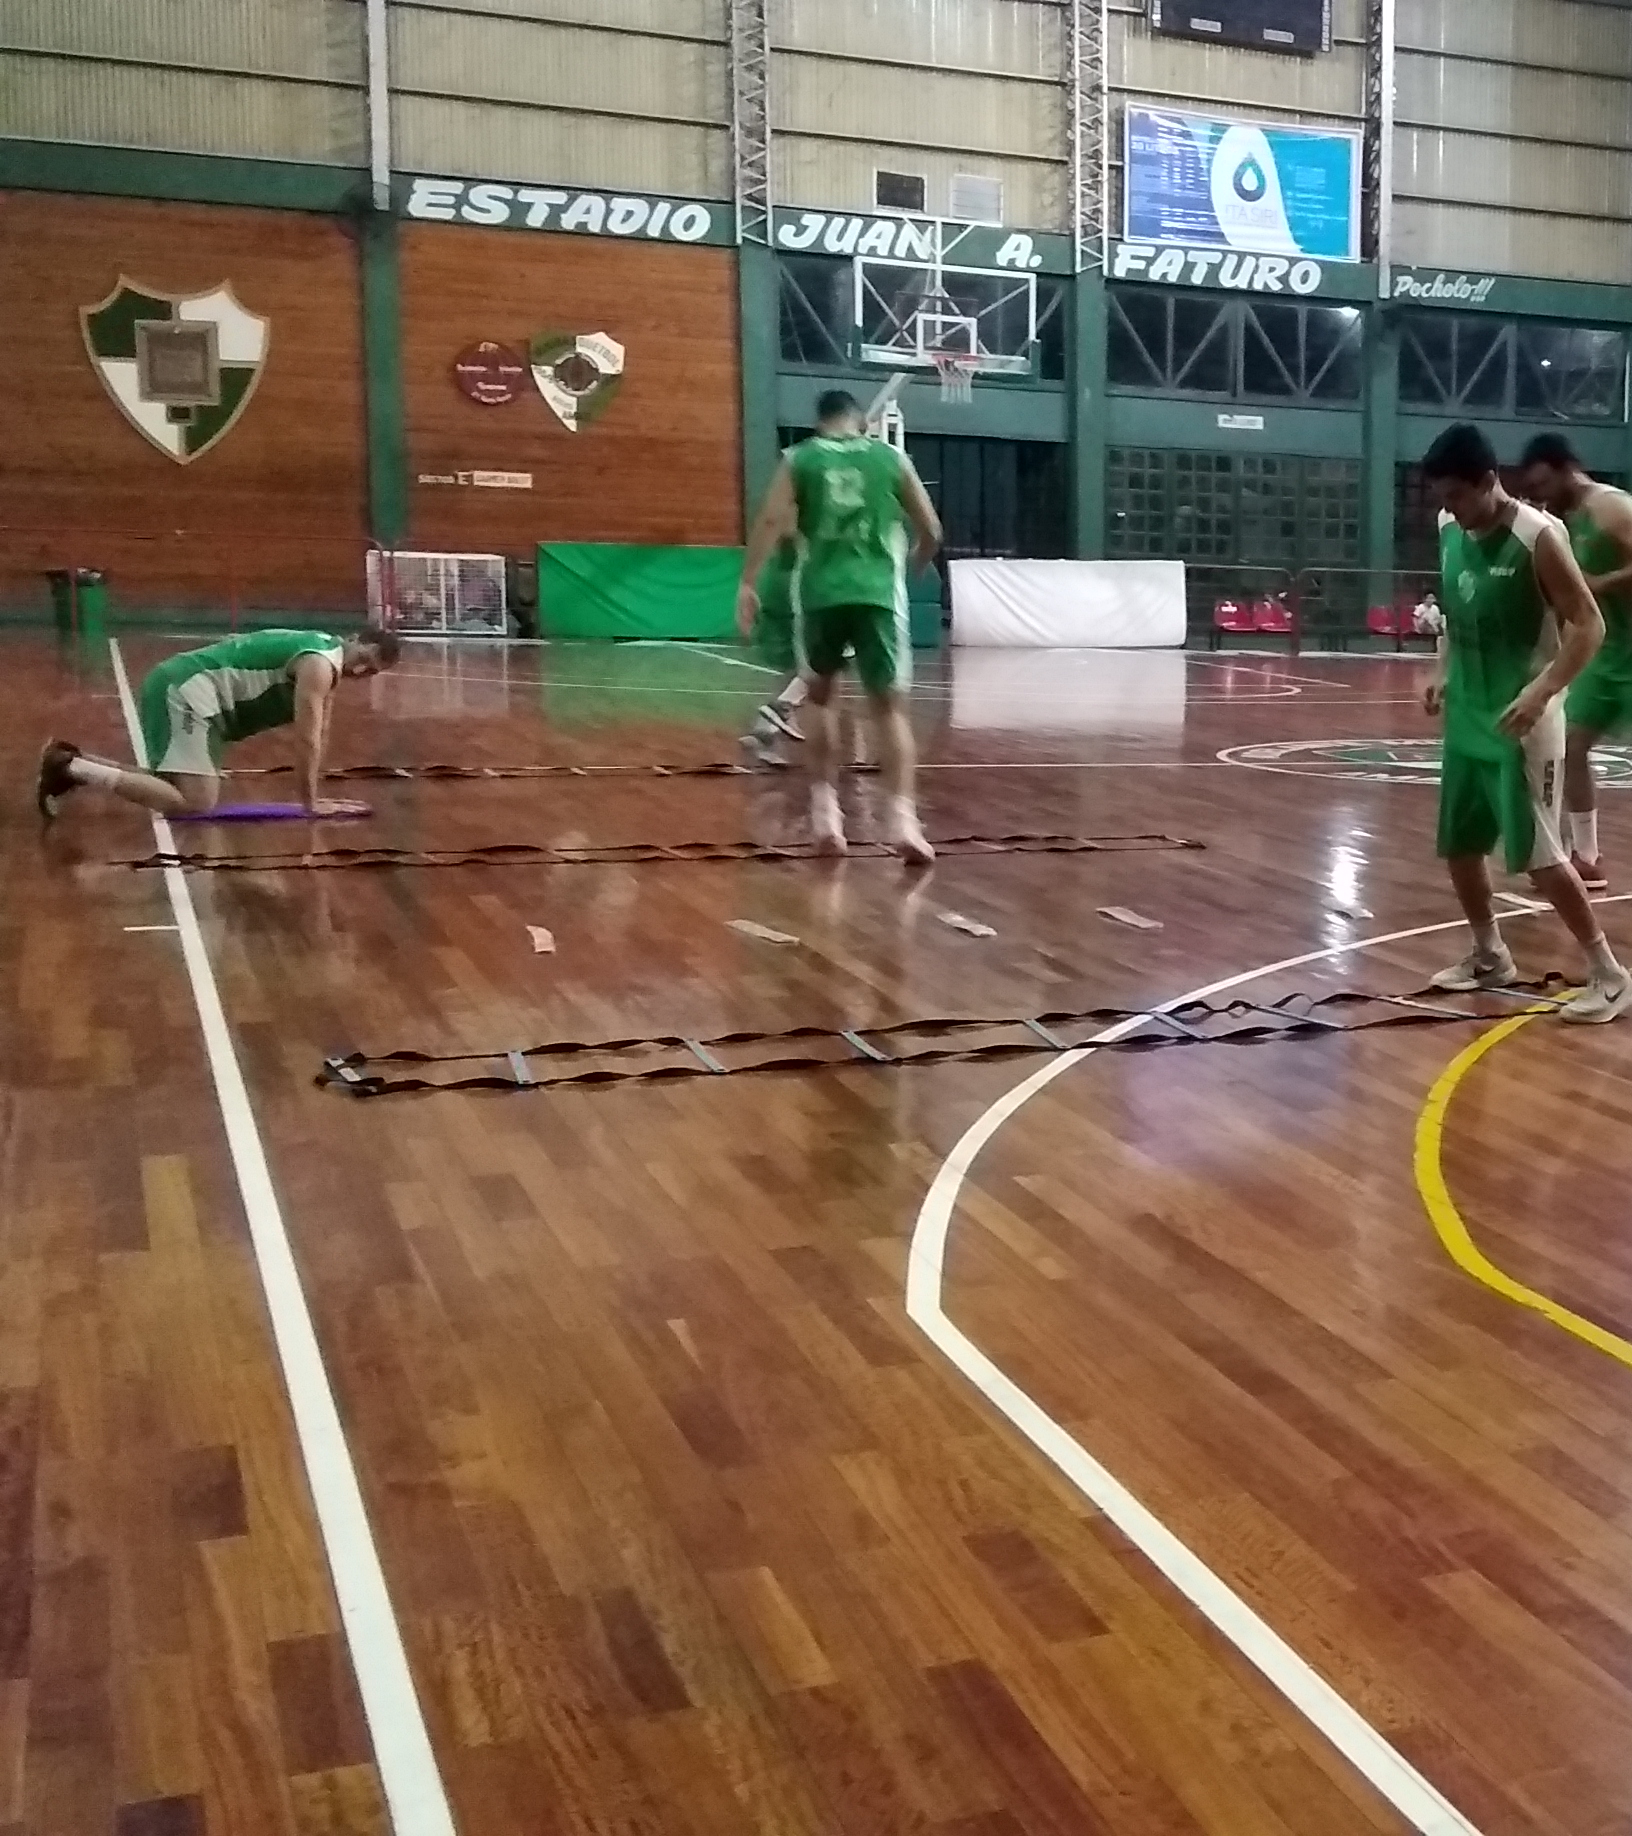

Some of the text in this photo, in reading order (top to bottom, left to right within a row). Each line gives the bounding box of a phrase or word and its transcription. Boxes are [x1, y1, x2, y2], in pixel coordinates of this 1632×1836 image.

[407, 178, 1322, 295] ESTADIO JUAN A. FATURO
